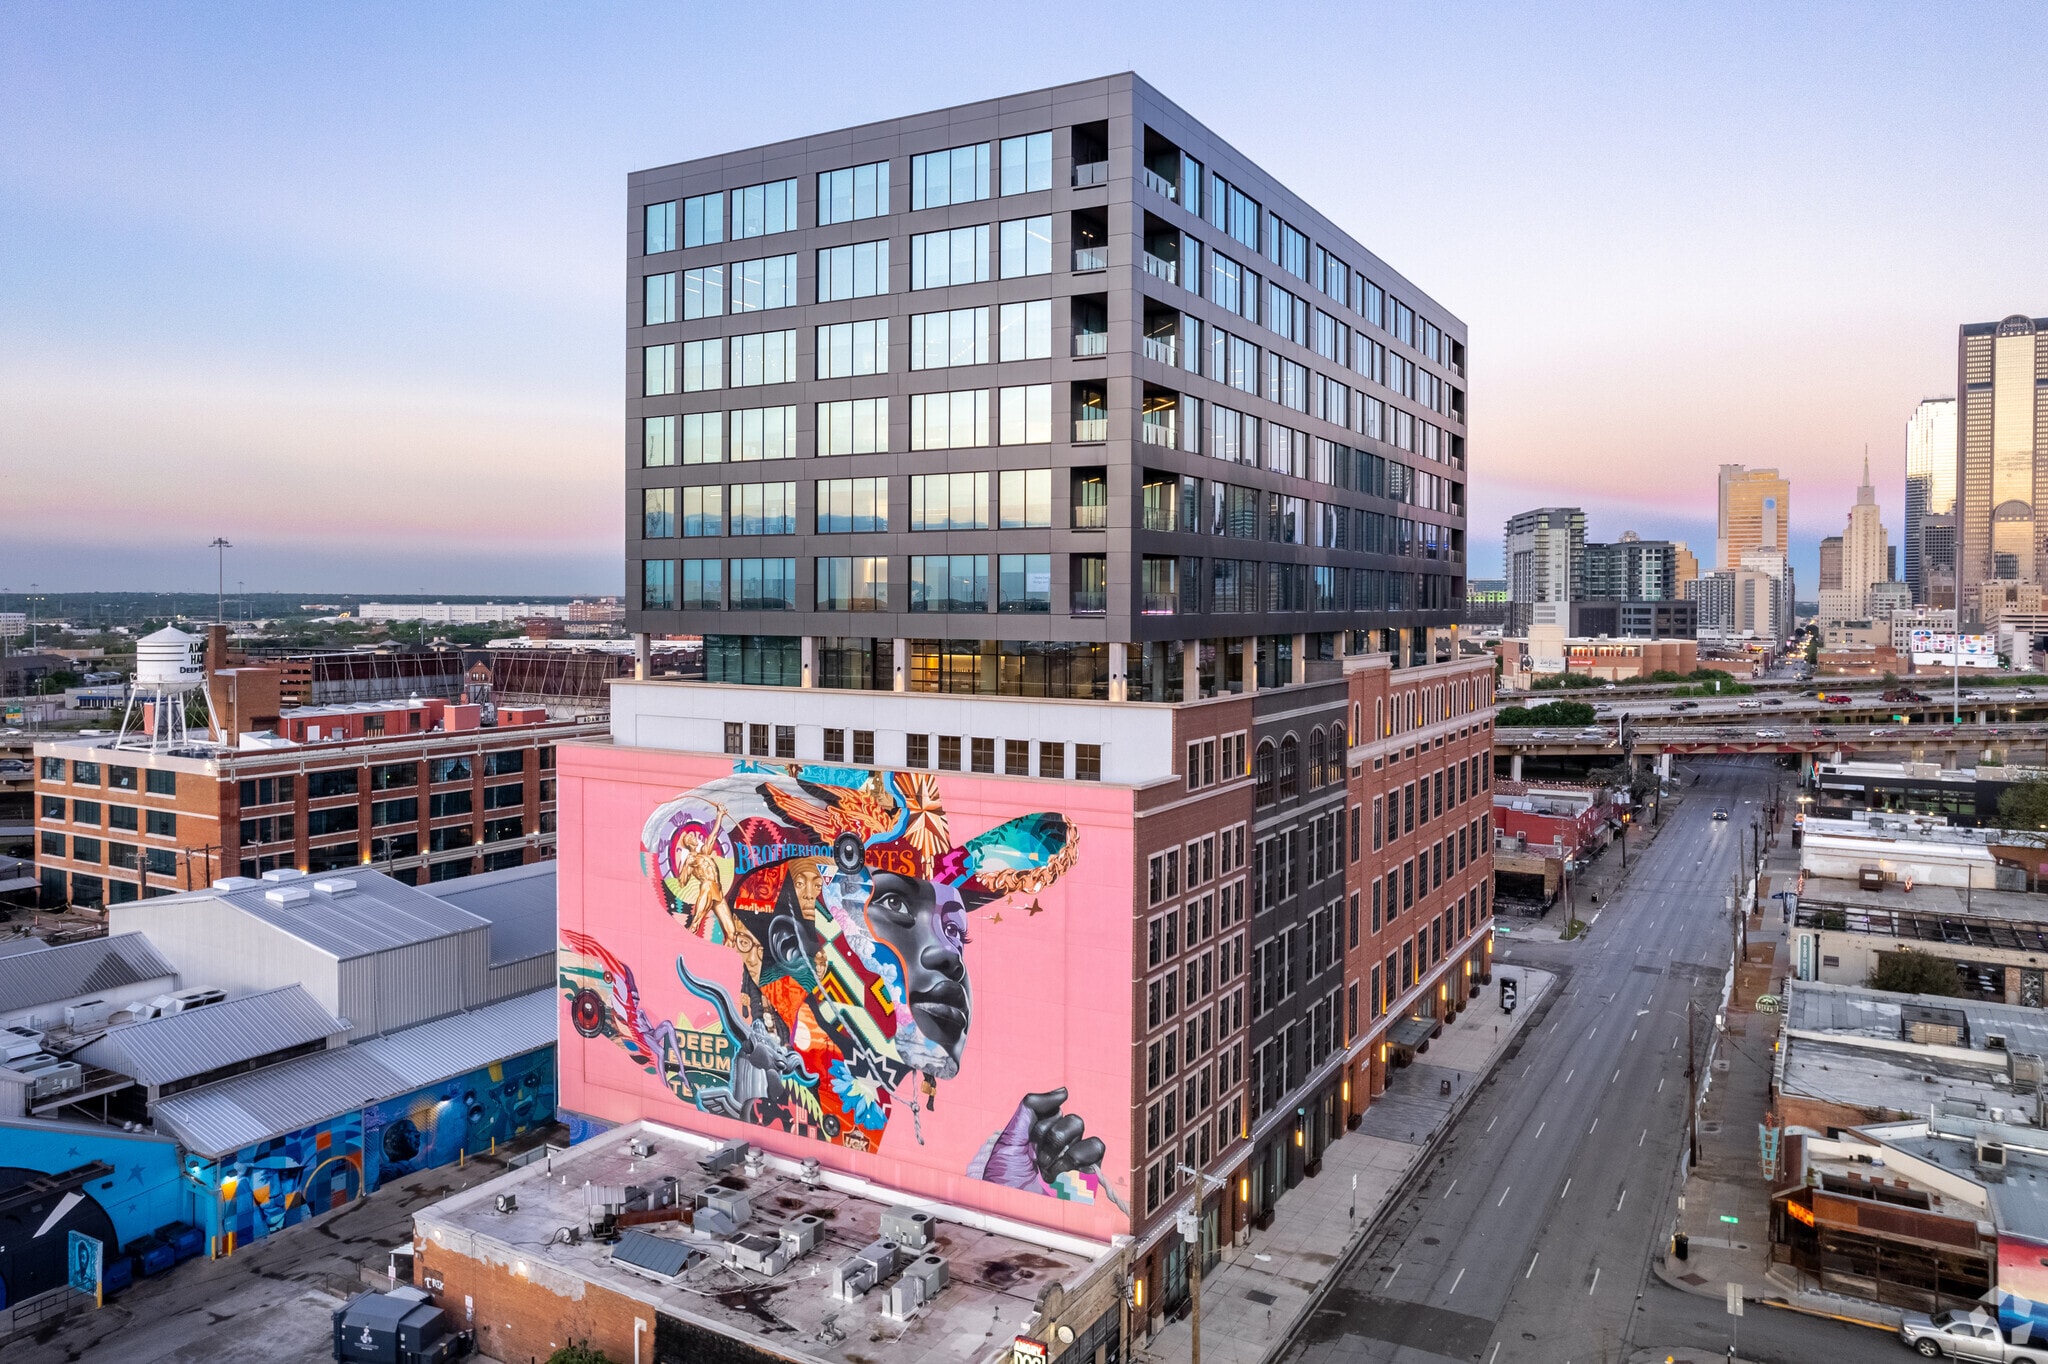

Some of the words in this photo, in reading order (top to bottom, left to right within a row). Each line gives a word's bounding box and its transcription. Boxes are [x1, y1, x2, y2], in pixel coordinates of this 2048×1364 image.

[735, 840, 834, 875] BROTHERHOOD
[866, 849, 915, 877] EYES
[668, 1048, 730, 1071] ELLUM
